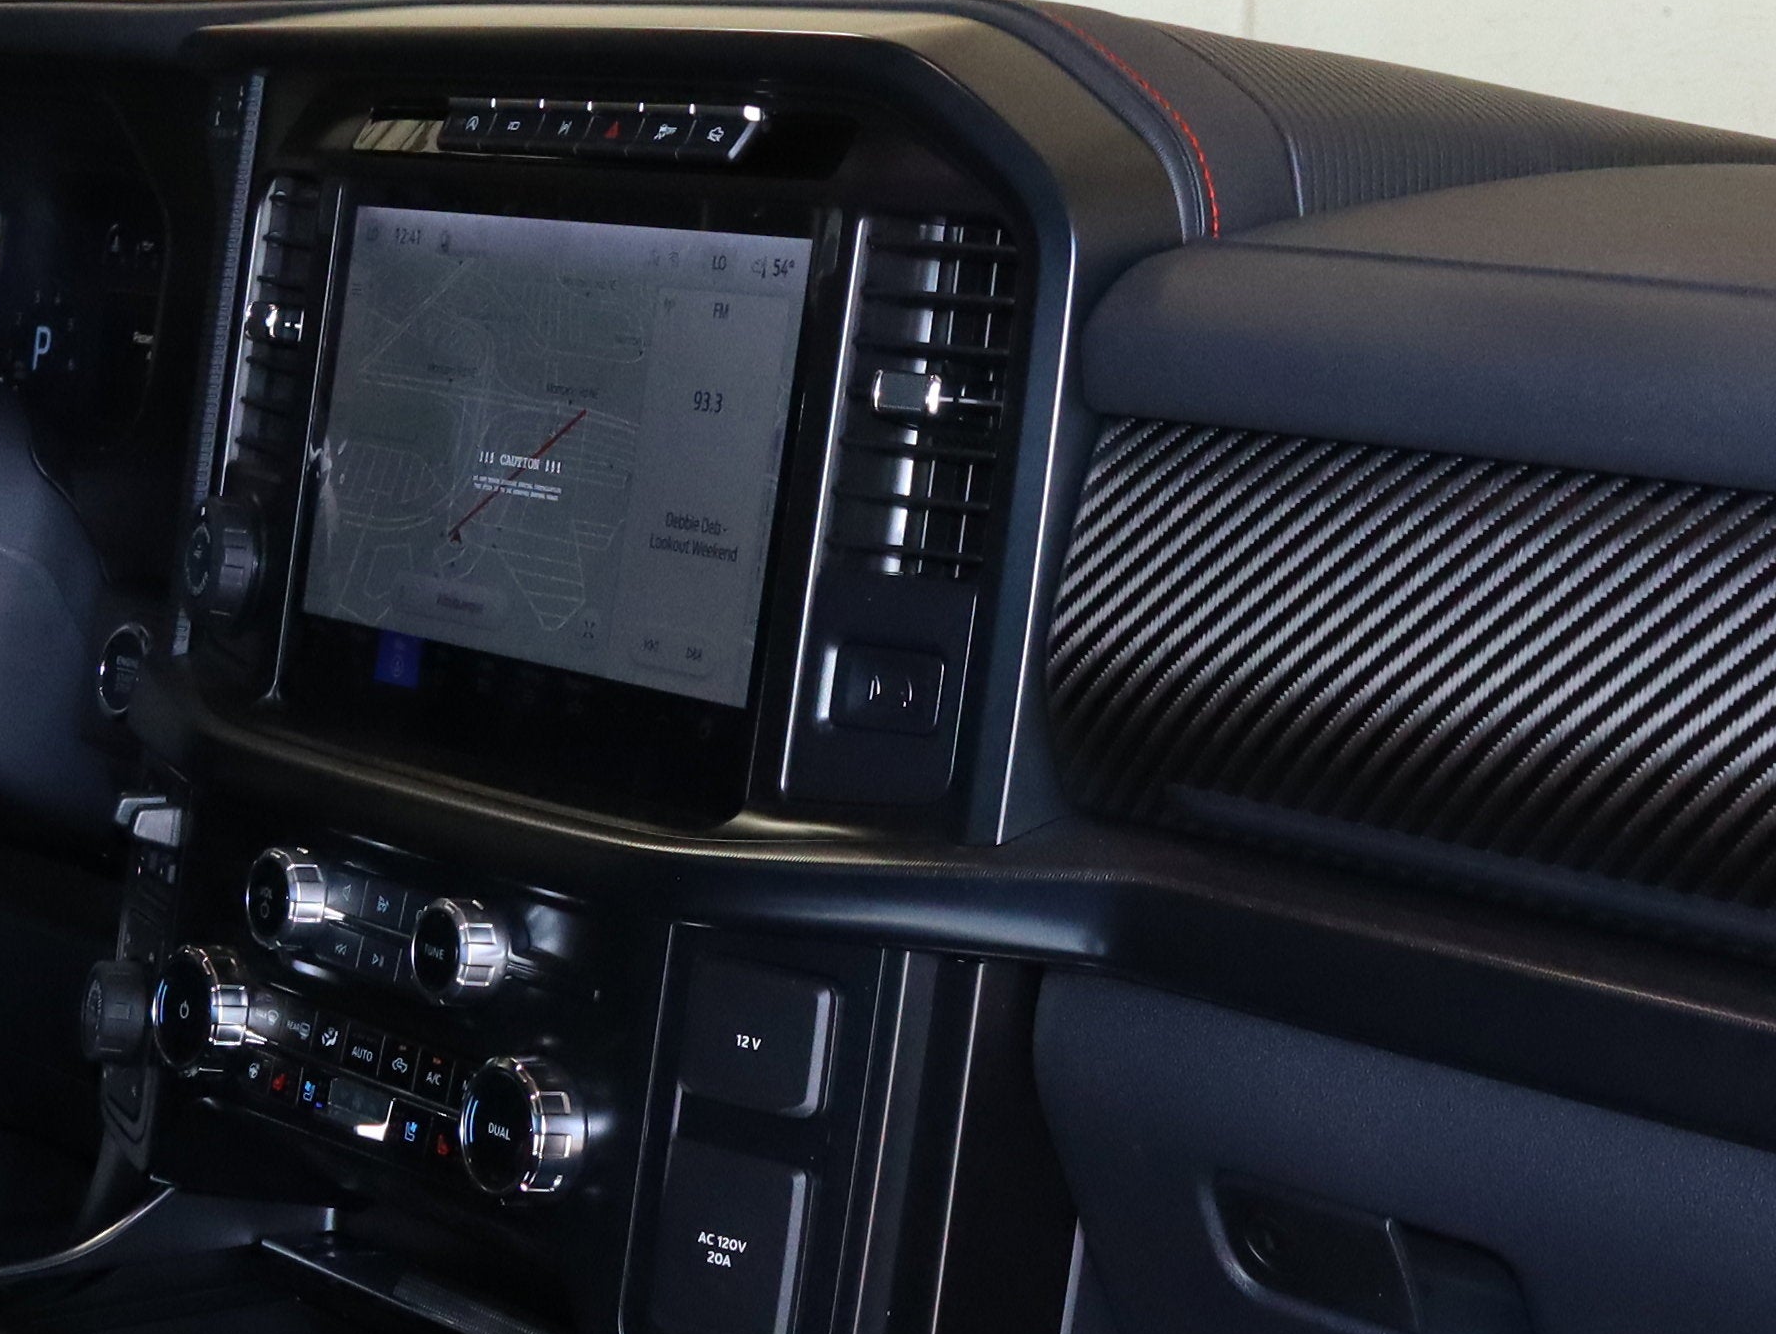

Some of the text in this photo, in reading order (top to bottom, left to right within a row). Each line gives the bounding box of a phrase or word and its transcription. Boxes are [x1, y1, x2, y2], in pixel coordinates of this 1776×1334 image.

[713, 301, 729, 318] FM
[31, 325, 53, 372] P
[693, 390, 723, 414] 93.3
[499, 453, 540, 471] CAUTION
[424, 942, 446, 961] TUNE
[350, 1044, 374, 1063] AUTO
[425, 1070, 443, 1087] A/C
[487, 1121, 512, 1142] DUAL
[697, 1230, 748, 1254] AC 120V
[706, 1250, 732, 1269] 20A
